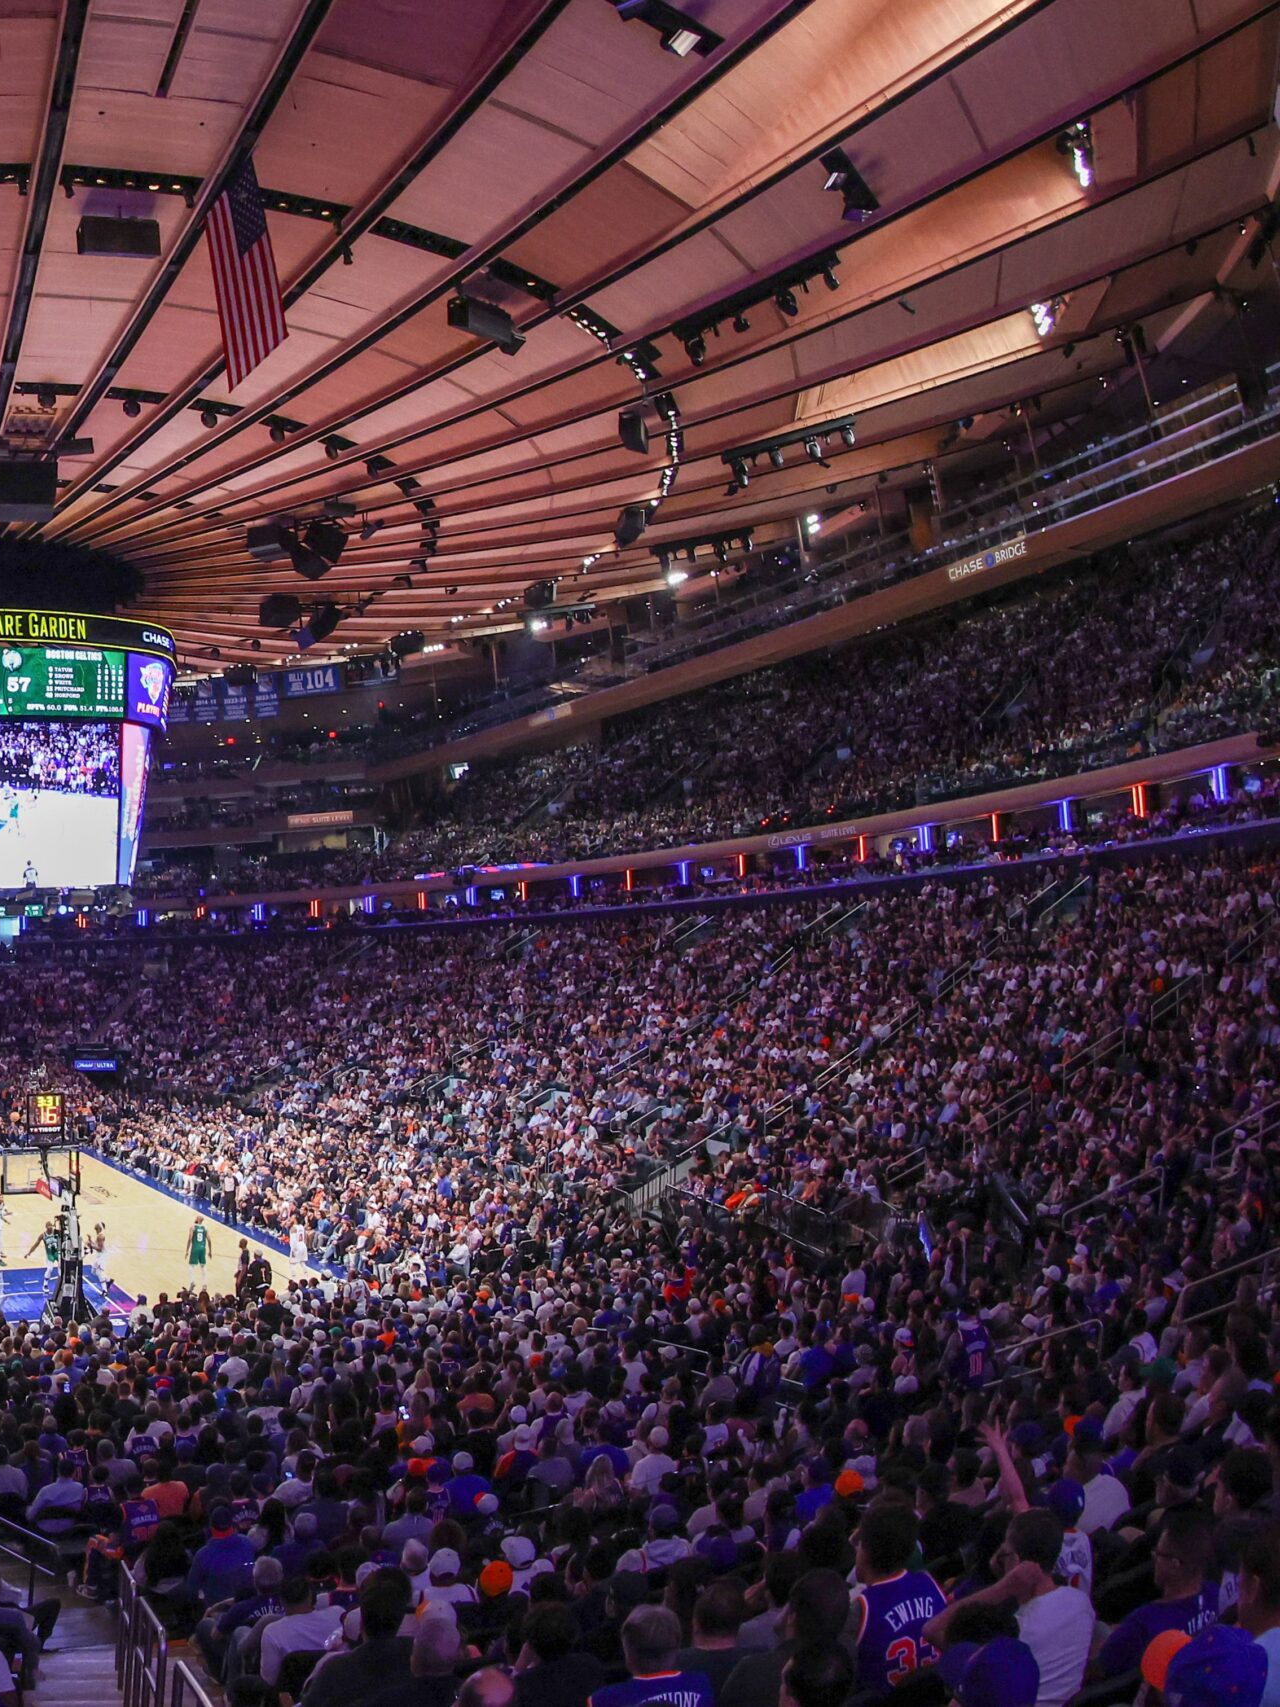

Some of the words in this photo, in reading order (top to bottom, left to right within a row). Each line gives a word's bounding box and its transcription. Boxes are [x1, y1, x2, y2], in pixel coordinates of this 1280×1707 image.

[948, 558, 983, 580] CHASE
[995, 542, 1027, 563] BRIDGE
[28, 613, 86, 640] GARDEN
[142, 632, 170, 648] CHASE
[6, 676, 31, 692] 57
[306, 668, 334, 690] 104
[37, 1096, 60, 1107] 3:31
[40, 1106, 57, 1124] 16
[884, 1596, 934, 1632] EWING
